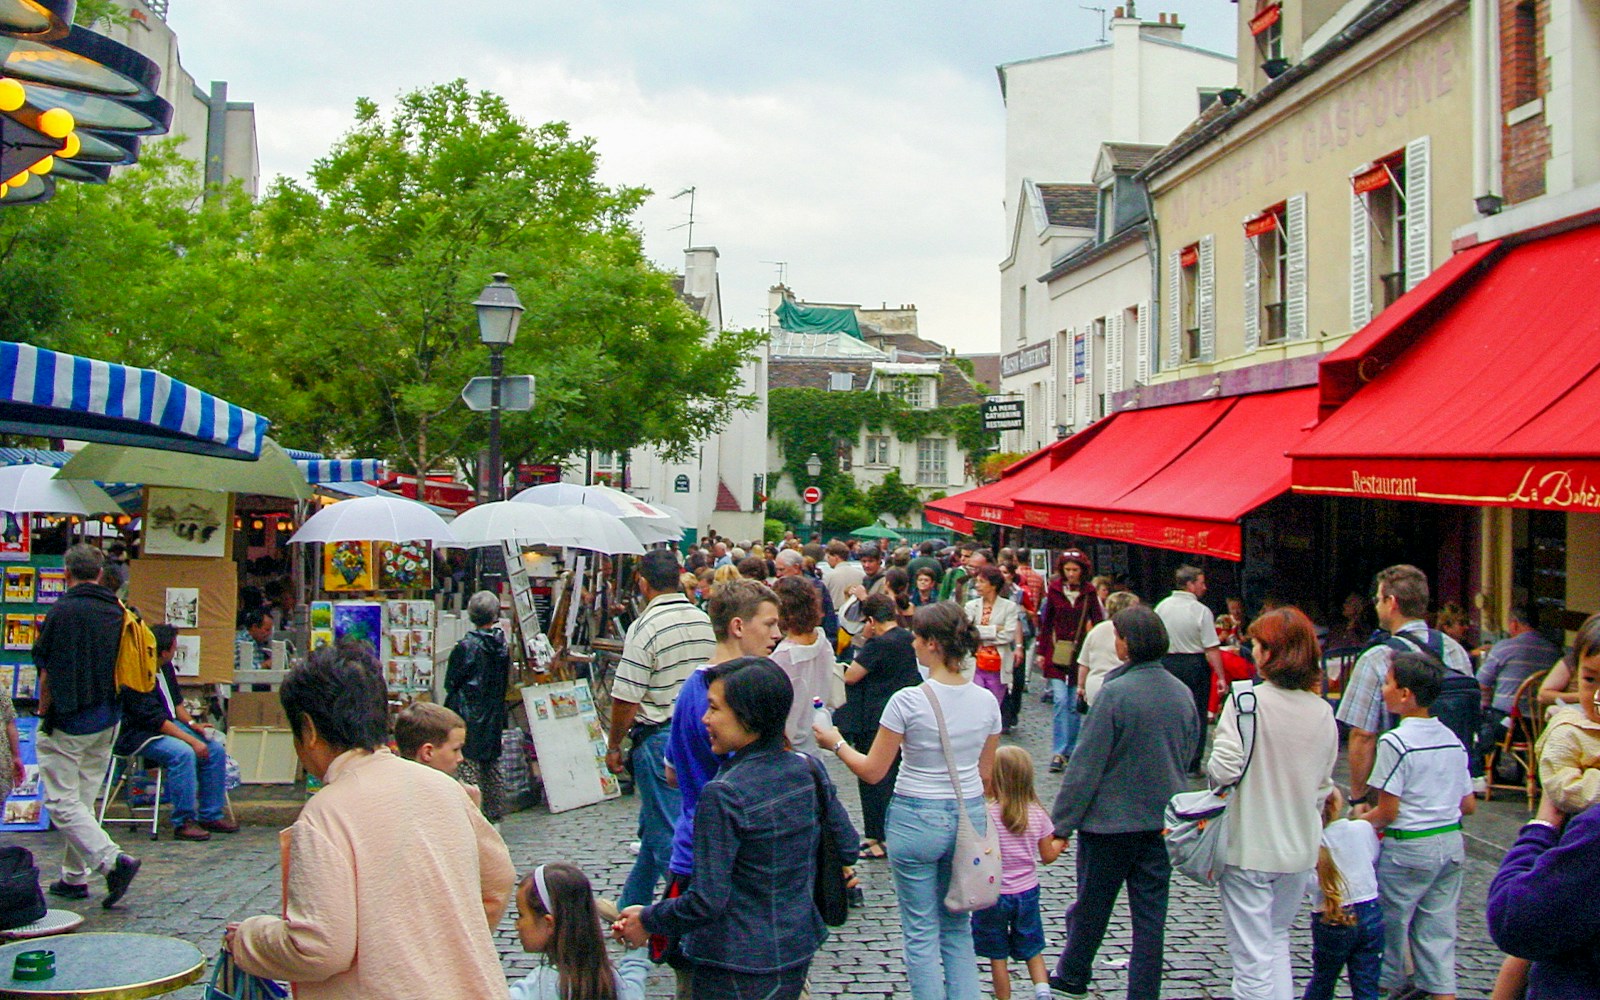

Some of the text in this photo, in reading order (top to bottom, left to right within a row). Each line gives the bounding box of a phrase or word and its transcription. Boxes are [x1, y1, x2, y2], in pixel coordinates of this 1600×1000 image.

[1303, 41, 1452, 163] GASCOGNE
[985, 411, 1021, 419] CATHERINE
[1352, 470, 1417, 496] Restaurant
[1508, 464, 1538, 502] La
